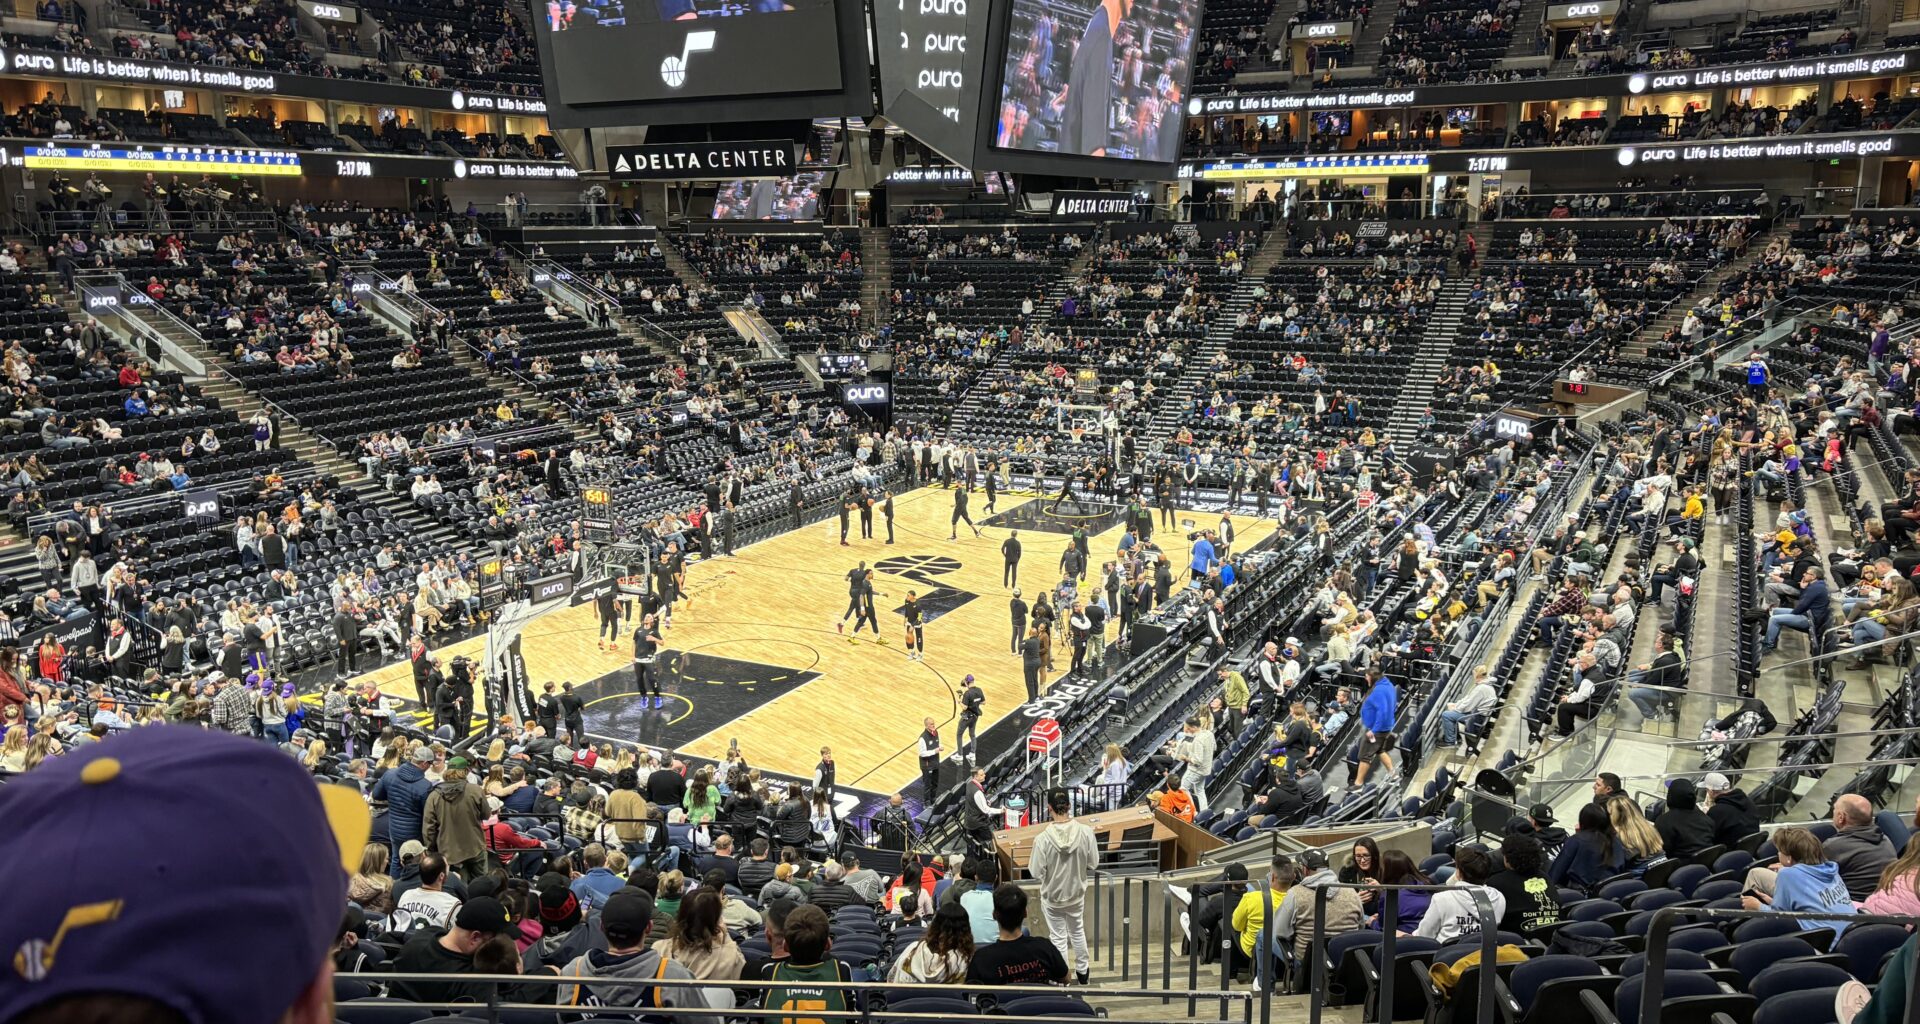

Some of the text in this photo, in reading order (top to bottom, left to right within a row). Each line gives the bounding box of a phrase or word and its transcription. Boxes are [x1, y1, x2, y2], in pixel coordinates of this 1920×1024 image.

[314, 4, 342, 18] pura
[1568, 3, 1600, 16] pura
[1308, 24, 1336, 37] pura
[15, 53, 274, 90] pura Life is better when it smells good
[918, 70, 962, 88] pura
[1652, 54, 1905, 89] pura Life is better when it smells good
[468, 96, 493, 109] pura
[497, 98, 515, 110] Life
[516, 98, 524, 110] is
[1207, 91, 1414, 112] pura Life is better when it smells good
[1642, 138, 1892, 162] pura Life is better when it smells good
[336, 160, 372, 176] 7:17 PM
[634, 150, 786, 170] DELTA CENTER
[1468, 157, 1507, 171] 7:17 PM
[470, 164, 578, 178] pura Life is better whe
[892, 168, 923, 180] better
[952, 168, 960, 180] it
[1067, 198, 1129, 214] DELTA CENTER
[535, 274, 550, 282] pura
[352, 283, 370, 292] pura
[90, 296, 117, 308] pura
[848, 386, 884, 402] pura
[1498, 418, 1528, 438] pura
[187, 500, 216, 516] pura
[542, 582, 564, 597] pura
[514, 654, 530, 717] AMERICA FIRST
[402, 902, 440, 921] STOCKTON
[1536, 917, 1556, 925] EAT
[782, 999, 827, 1024] 15
